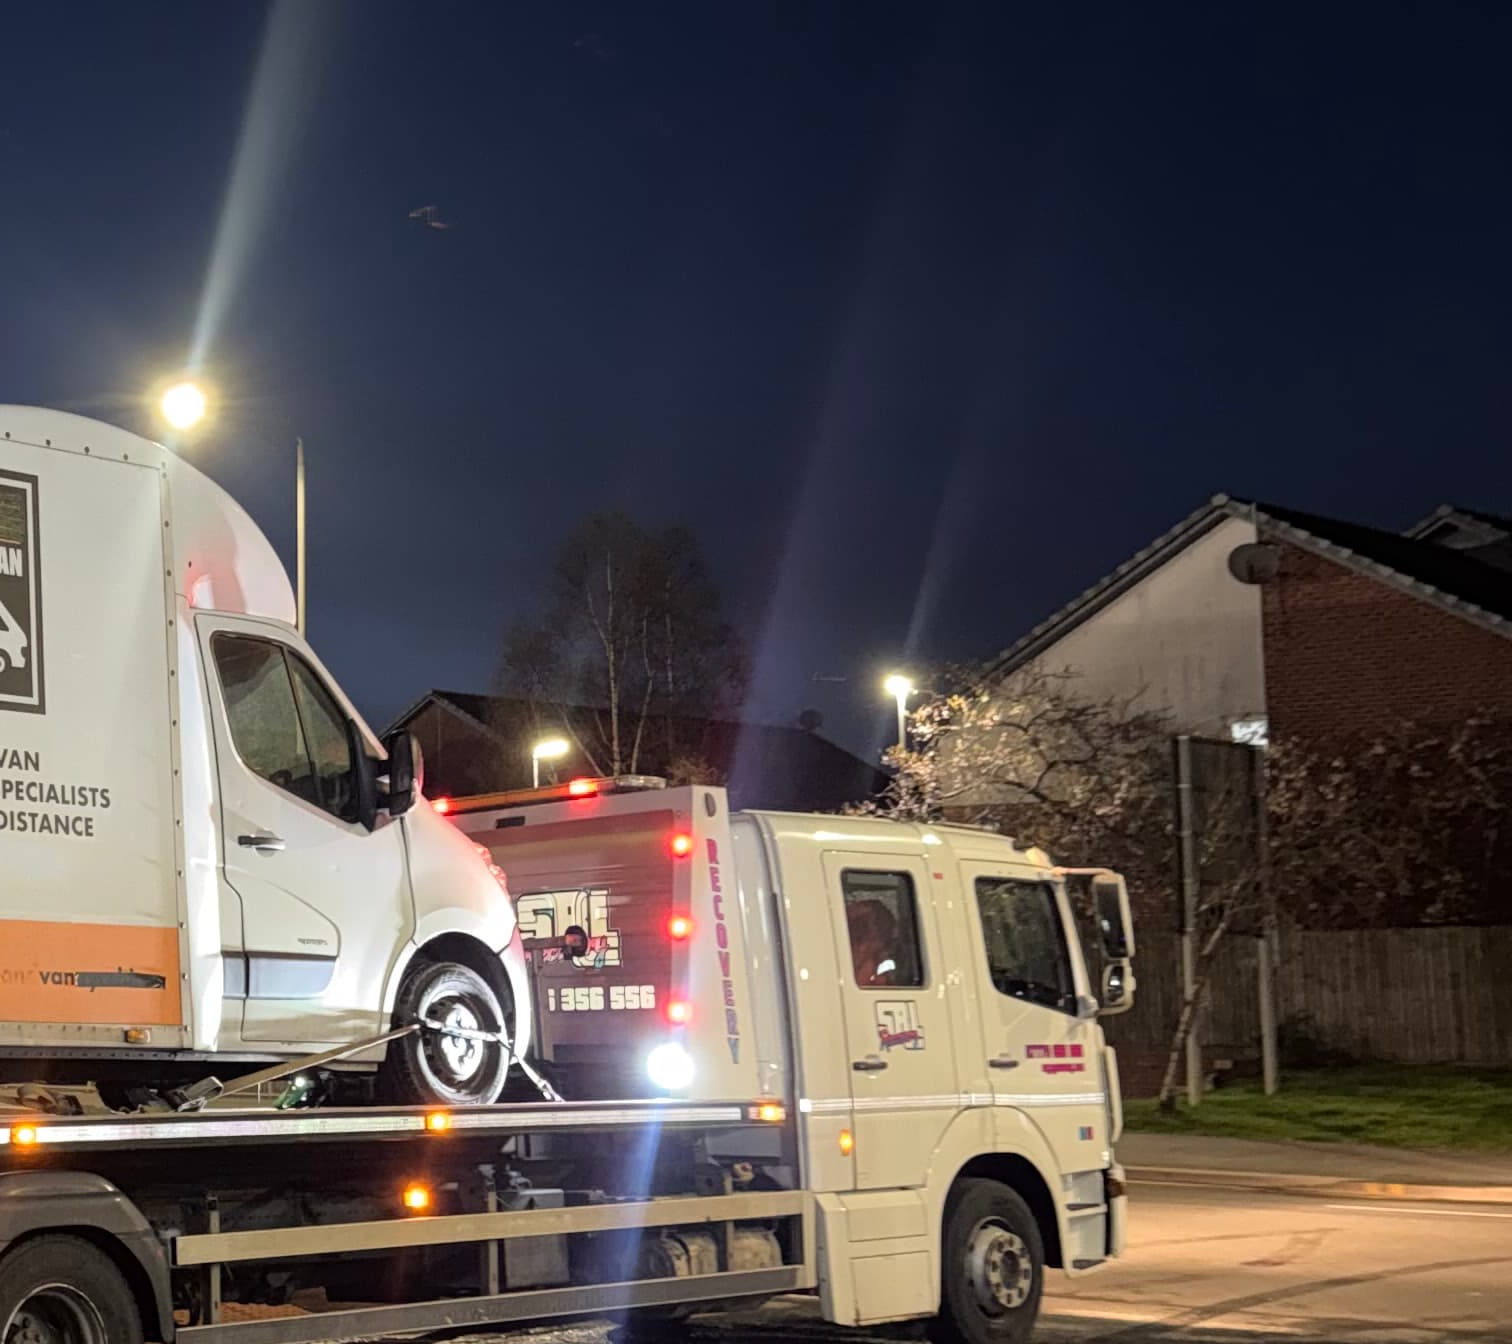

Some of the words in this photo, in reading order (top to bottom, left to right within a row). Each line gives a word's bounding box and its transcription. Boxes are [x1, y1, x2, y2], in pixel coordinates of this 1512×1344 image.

[560, 987, 604, 1011] 356
[610, 985, 655, 1009] 556
[706, 838, 740, 1065] RECOVERY
